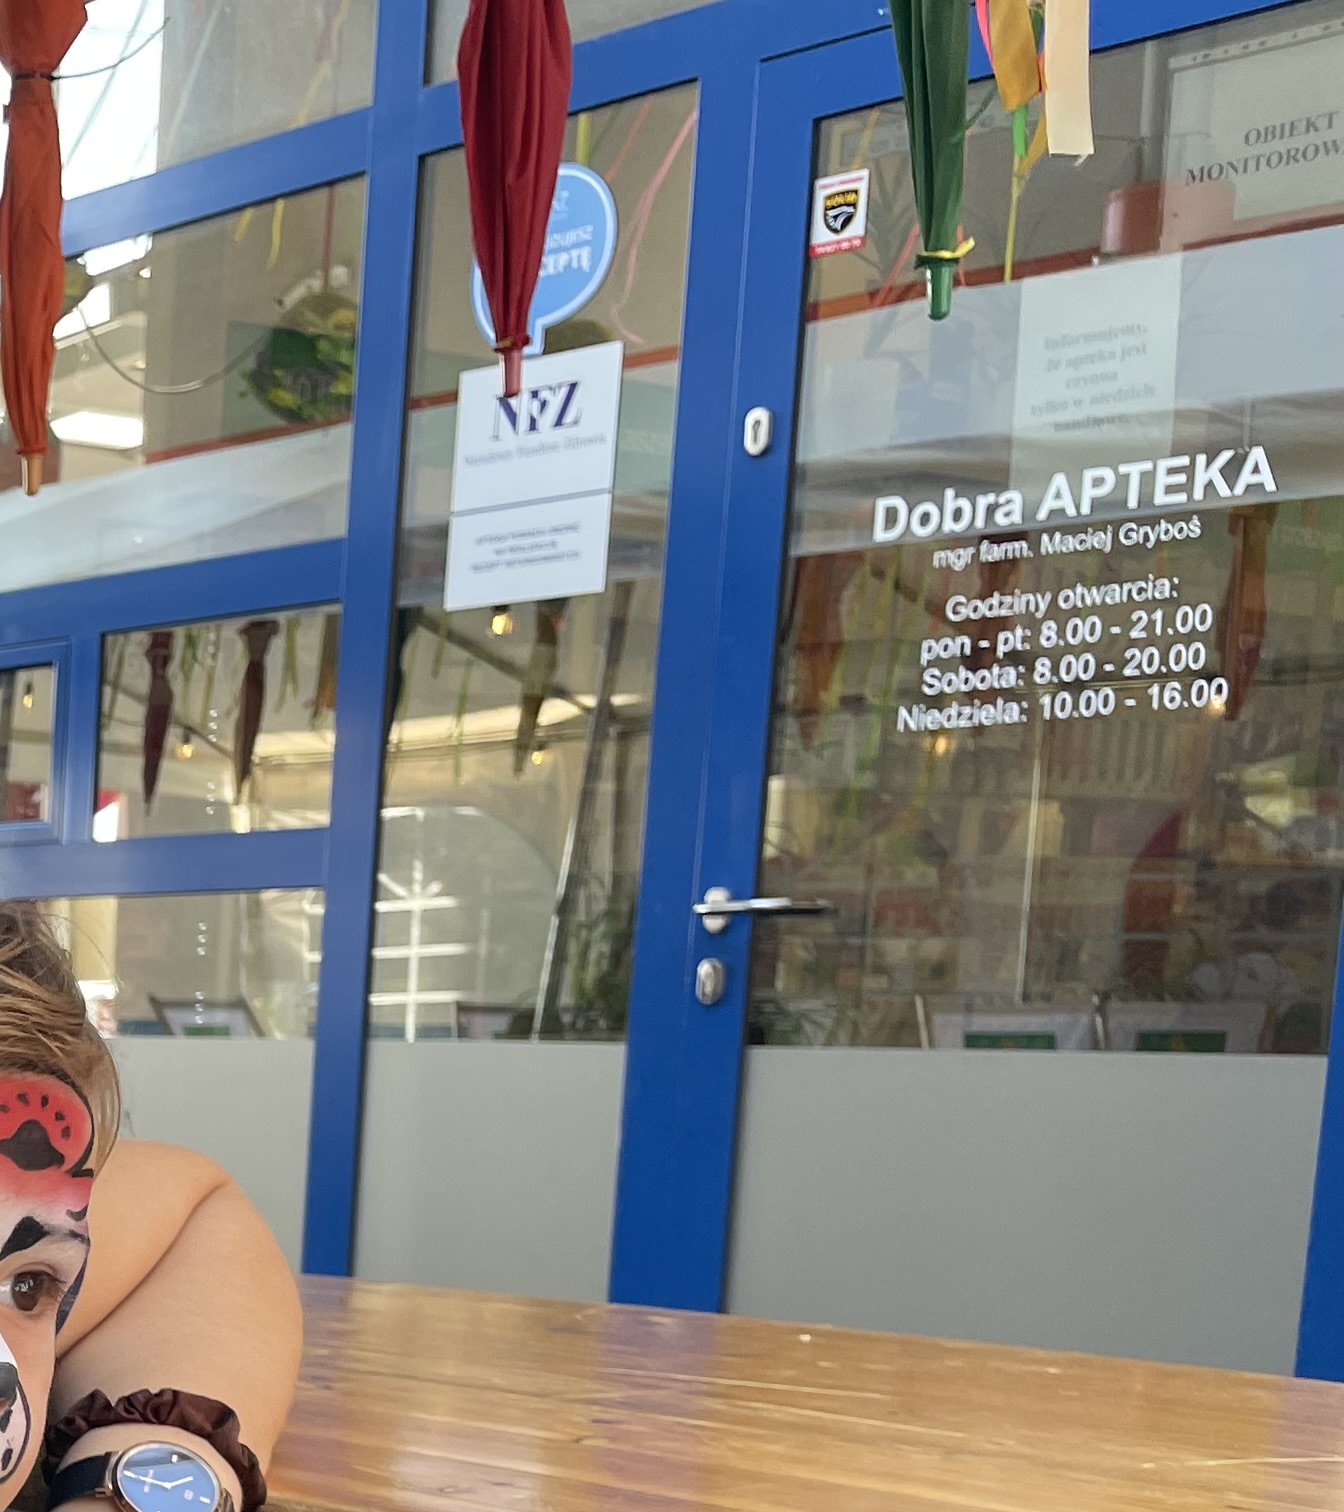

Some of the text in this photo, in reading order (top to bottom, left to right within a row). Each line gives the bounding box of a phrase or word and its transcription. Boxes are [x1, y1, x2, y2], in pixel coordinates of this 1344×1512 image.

[1244, 111, 1340, 146] OBIEKT
[1185, 138, 1344, 186] MONITOROW
[489, 380, 581, 442] NFZ
[872, 445, 1278, 543] Dobra APTEKA
[932, 515, 1202, 571] mgr farm. Maciej Gryboś
[945, 573, 1179, 622] Godziny otwarcia:
[920, 635, 972, 667] pon
[996, 624, 1032, 660] pt:
[1039, 615, 1102, 648] 8.00
[1129, 603, 1213, 639] 21.00
[921, 662, 1026, 696] Sobota:
[1033, 652, 1096, 685] 8.00
[1122, 641, 1206, 677] 20.00
[896, 696, 1028, 733] Niedziela:
[1039, 687, 1116, 720] 10.00
[1147, 677, 1229, 711] 16.00
